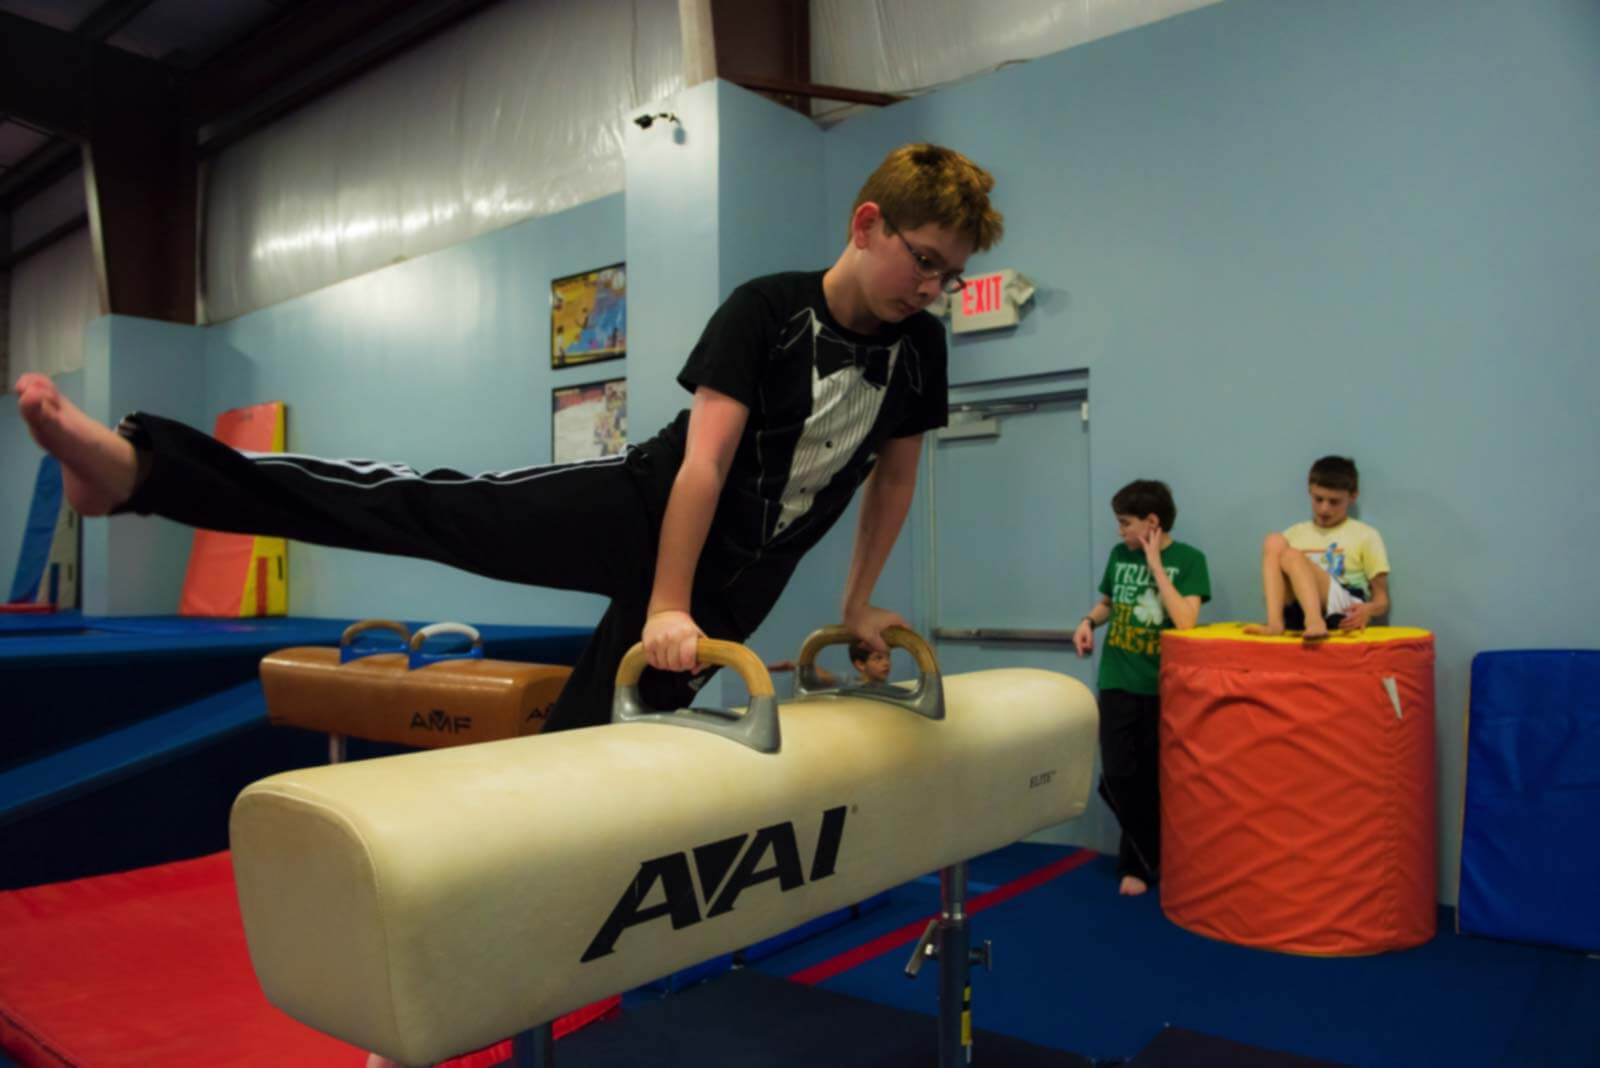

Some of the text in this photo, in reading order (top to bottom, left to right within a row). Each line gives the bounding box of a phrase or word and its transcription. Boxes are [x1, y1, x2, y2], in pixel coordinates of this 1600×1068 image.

[961, 274, 1003, 316] EXIT
[1114, 562, 1180, 586] TRUT
[410, 709, 472, 735] AMF
